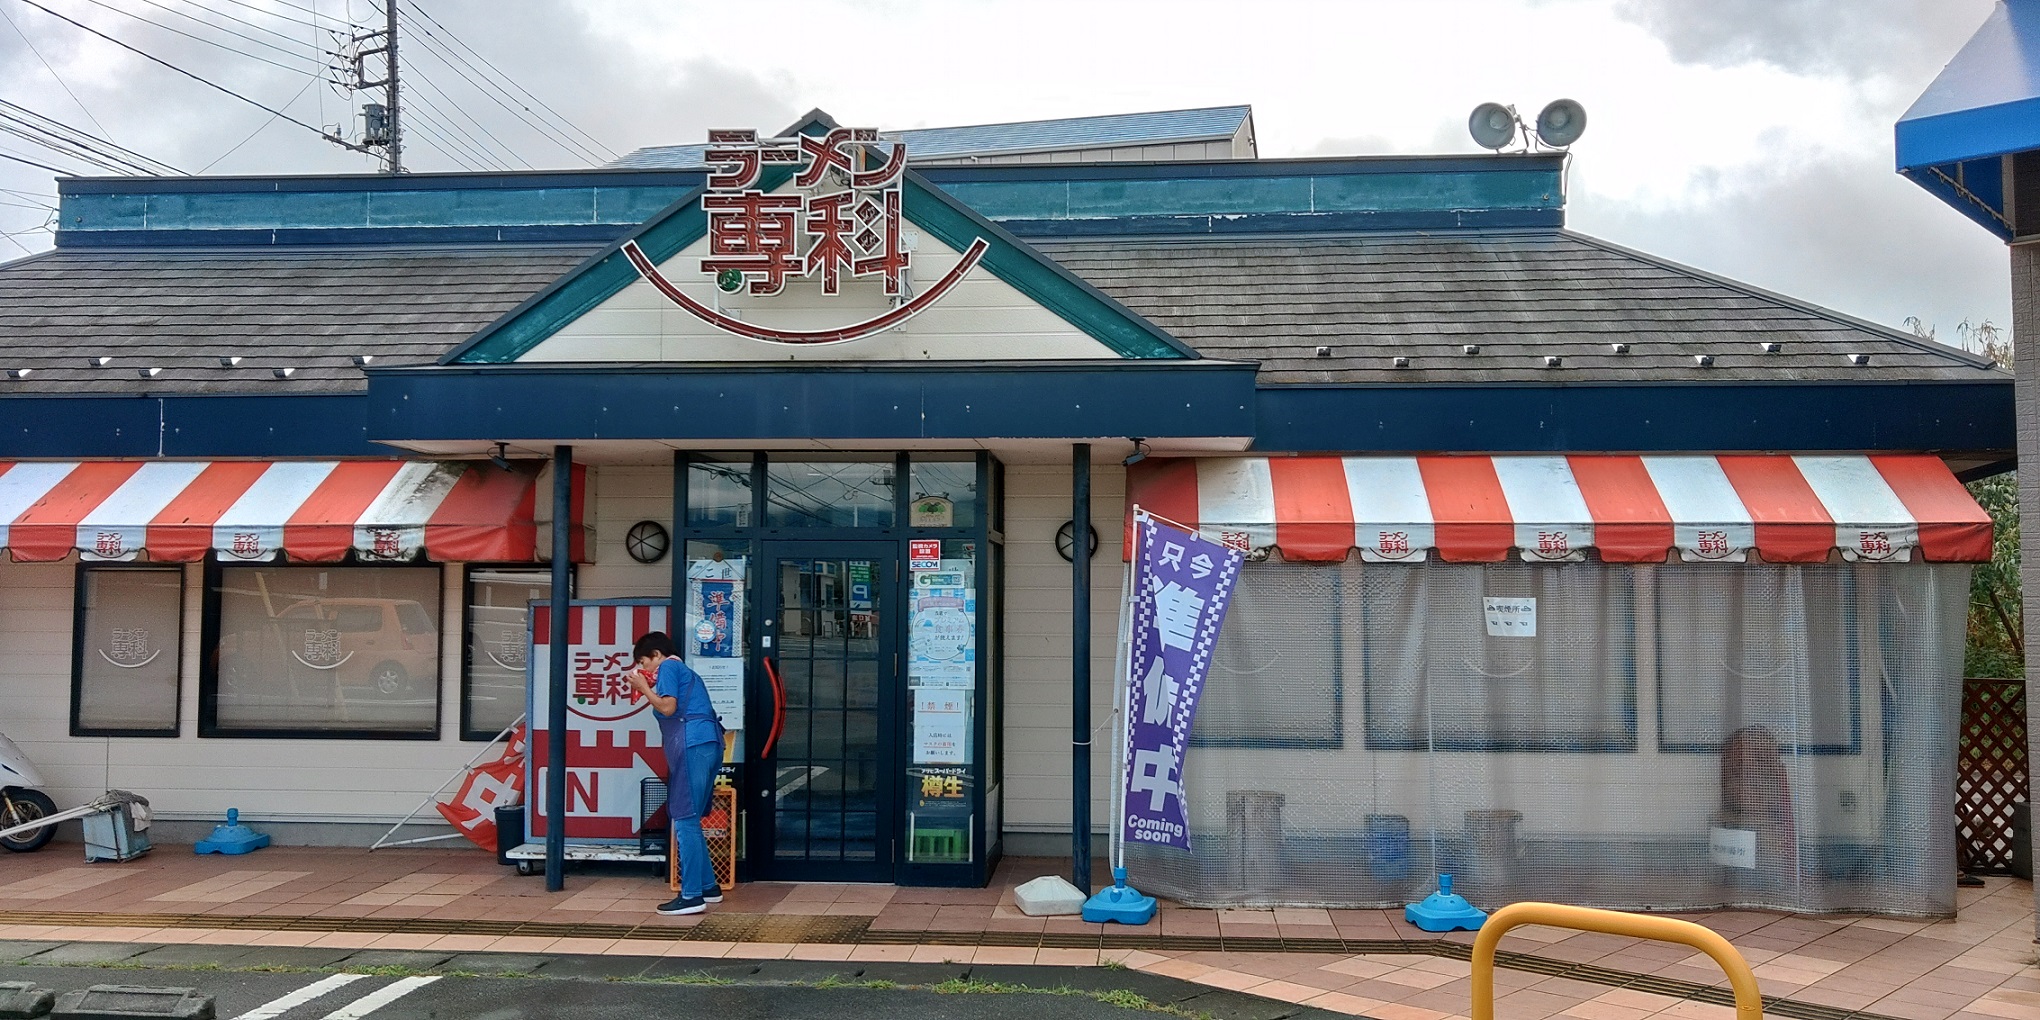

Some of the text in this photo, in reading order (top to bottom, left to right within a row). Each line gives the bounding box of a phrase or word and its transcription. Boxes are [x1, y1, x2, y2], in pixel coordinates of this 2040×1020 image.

[704, 127, 907, 189] ラーメン
[699, 189, 911, 296] 専科
[97, 532, 122, 540] ラーメン
[234, 533, 259, 541] ラーメン
[1222, 532, 1249, 540] ラーメン
[1379, 531, 1408, 540] ラーメン
[1538, 531, 1567, 540] ラーメン
[1698, 531, 1727, 540] ラーメン
[96, 540, 121, 554] 専科
[233, 541, 259, 554] 専科
[1379, 540, 1408, 554] 専科
[1538, 540, 1568, 554] 専科
[1698, 539, 1728, 554] 専科
[1860, 540, 1891, 554] 専科
[1158, 541, 1215, 579] 只今
[112, 628, 148, 640] ラーメン
[305, 629, 341, 641] ラーメン
[111, 640, 148, 660] 専科
[304, 640, 341, 660] 専科
[574, 652, 637, 671] ラーメン
[573, 672, 636, 705] 専科
[921, 775, 964, 797] 樽生
[1127, 814, 1183, 838] Coming
[1135, 829, 1171, 843] soon
